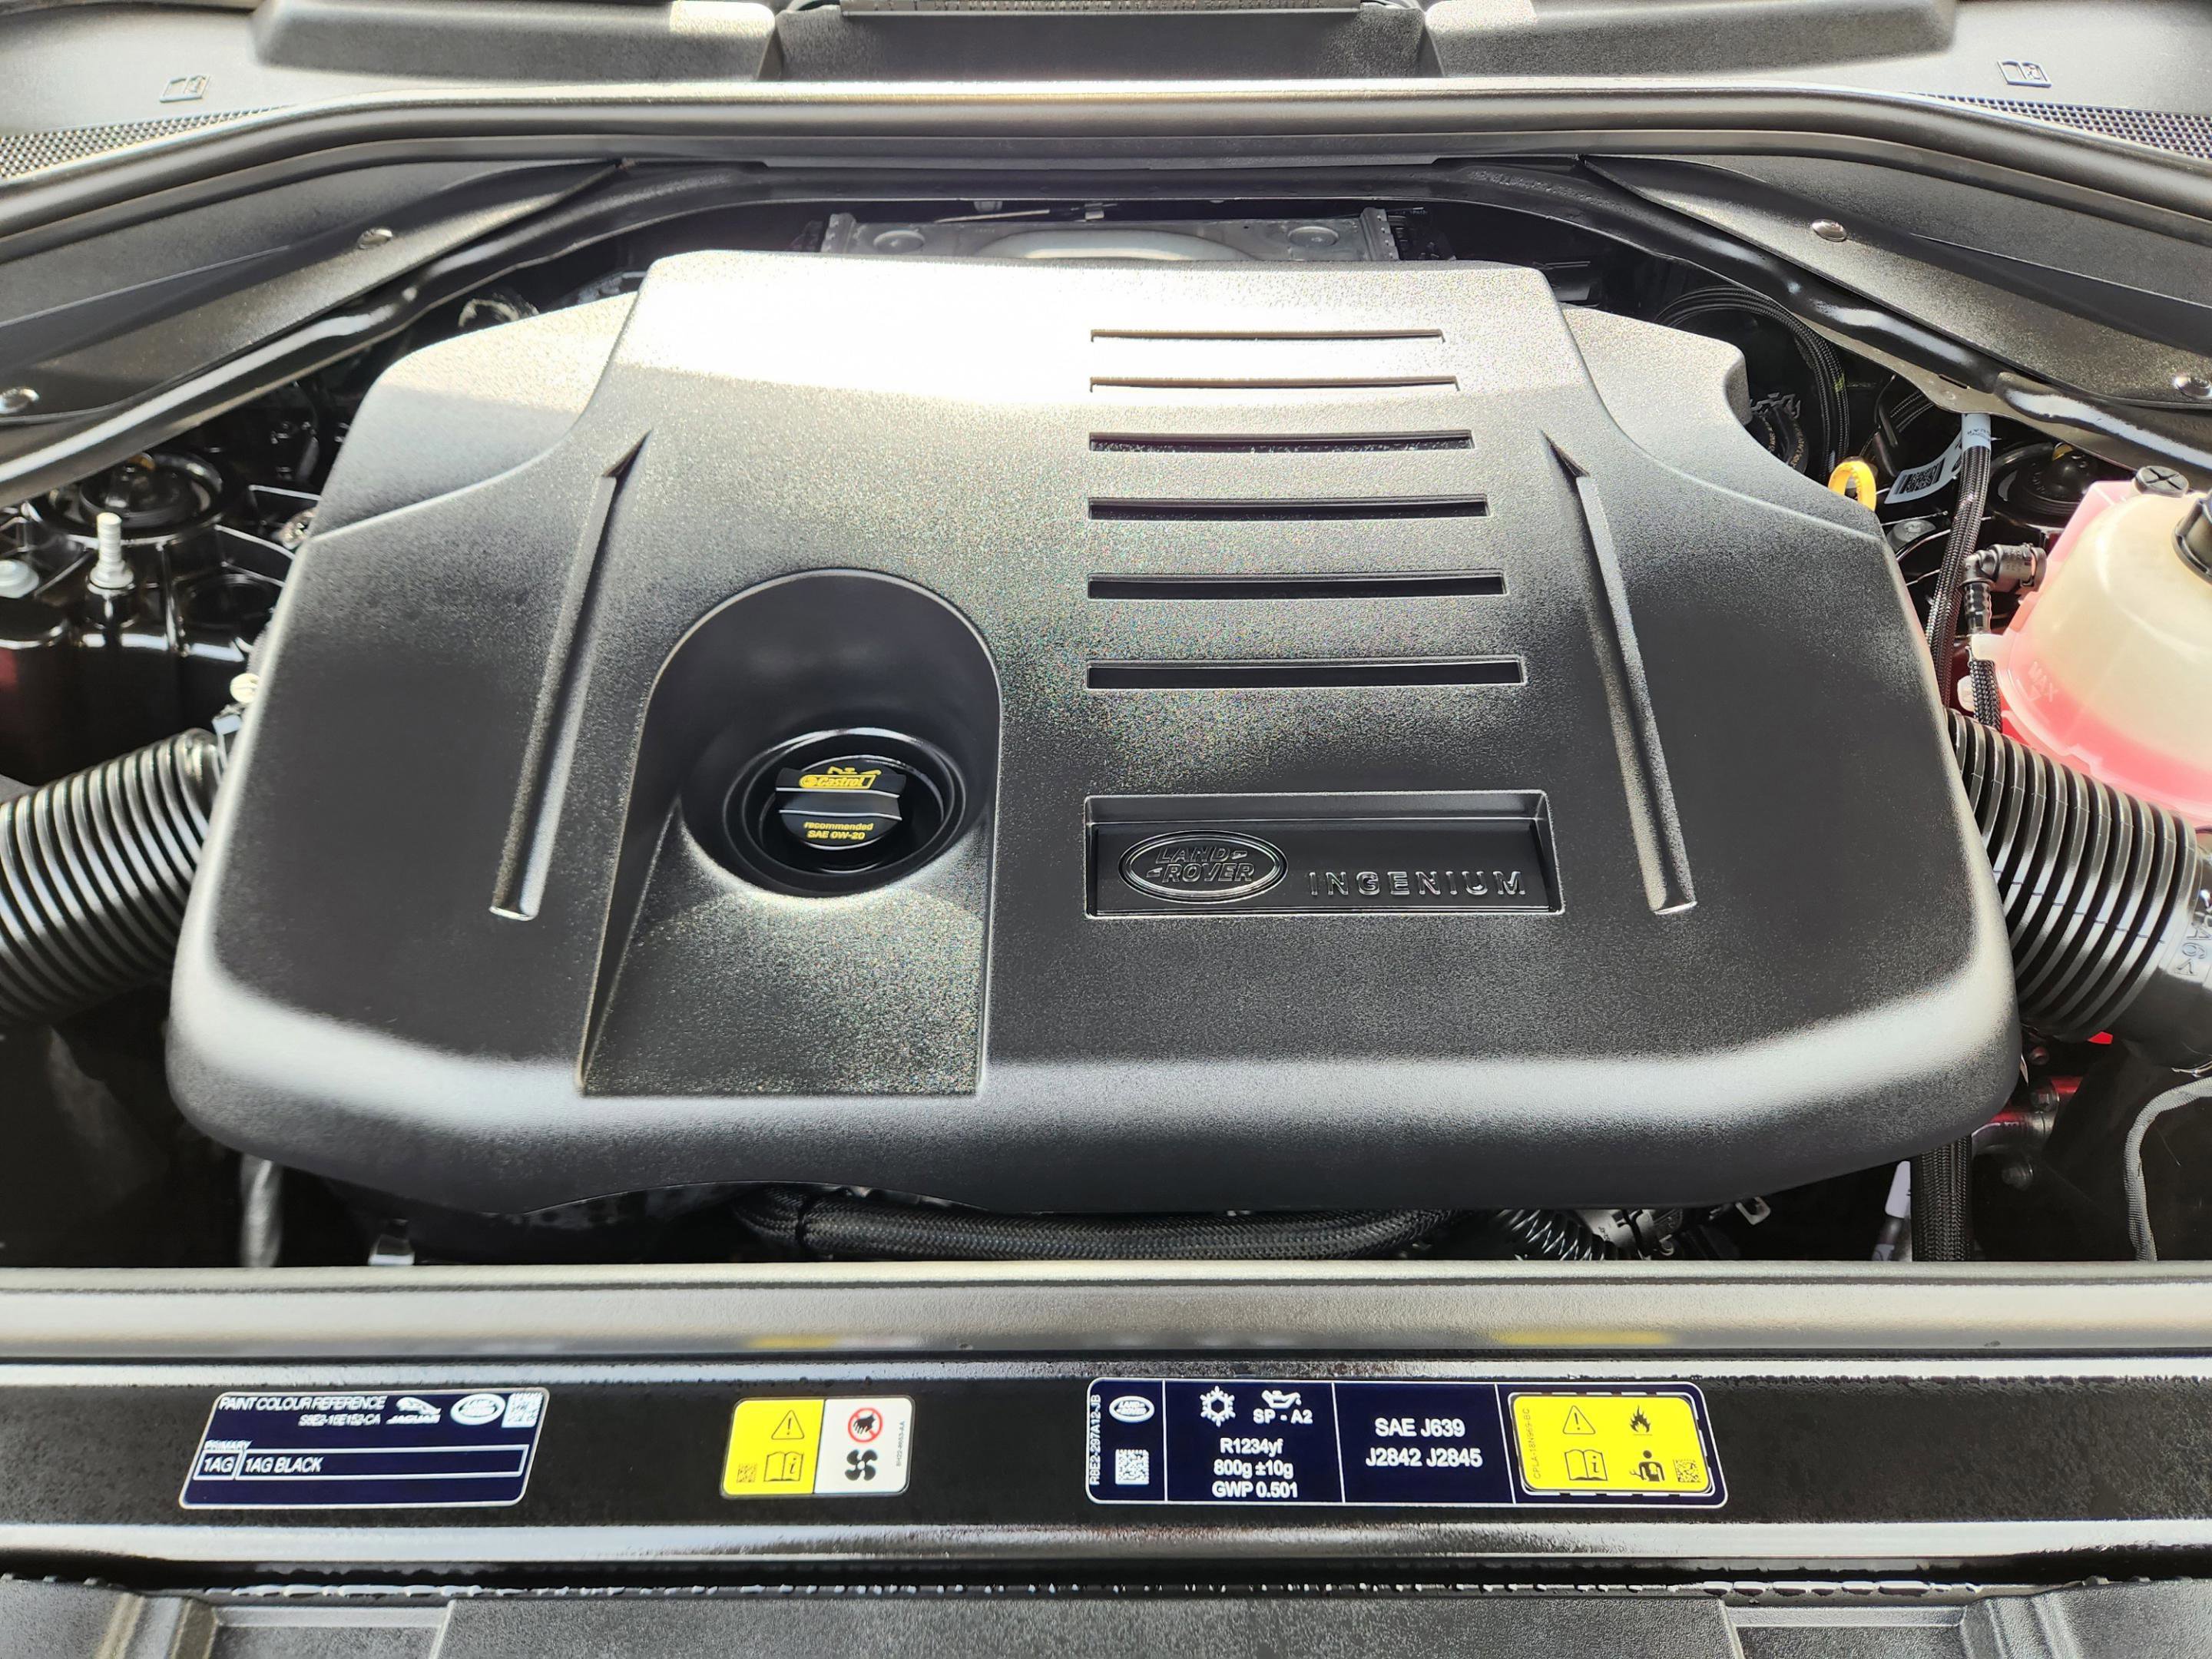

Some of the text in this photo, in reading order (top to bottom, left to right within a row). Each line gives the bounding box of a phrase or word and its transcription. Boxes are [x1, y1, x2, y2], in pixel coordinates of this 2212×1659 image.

[816, 777, 865, 787] Castrol
[803, 821, 874, 831] recommended
[806, 830, 866, 840] SAE 0W-20
[1155, 846, 1230, 864] LAND
[1161, 863, 1256, 883] ROVER
[1308, 870, 1527, 896] INGENIUM
[218, 1395, 388, 1411] PAINT COLOUR REFERENCE
[1253, 1408, 1277, 1424] SP
[1290, 1409, 1313, 1424] A2
[1374, 1417, 1465, 1437] SAE J639
[1220, 1437, 1283, 1457] R1234yf
[204, 1456, 236, 1473] 1AG
[245, 1456, 325, 1473] 1AG BLACK
[1365, 1447, 1483, 1468] J2842 J2845
[1214, 1459, 1294, 1479] 800g ±10g
[1211, 1480, 1298, 1498] GWP 0.501
